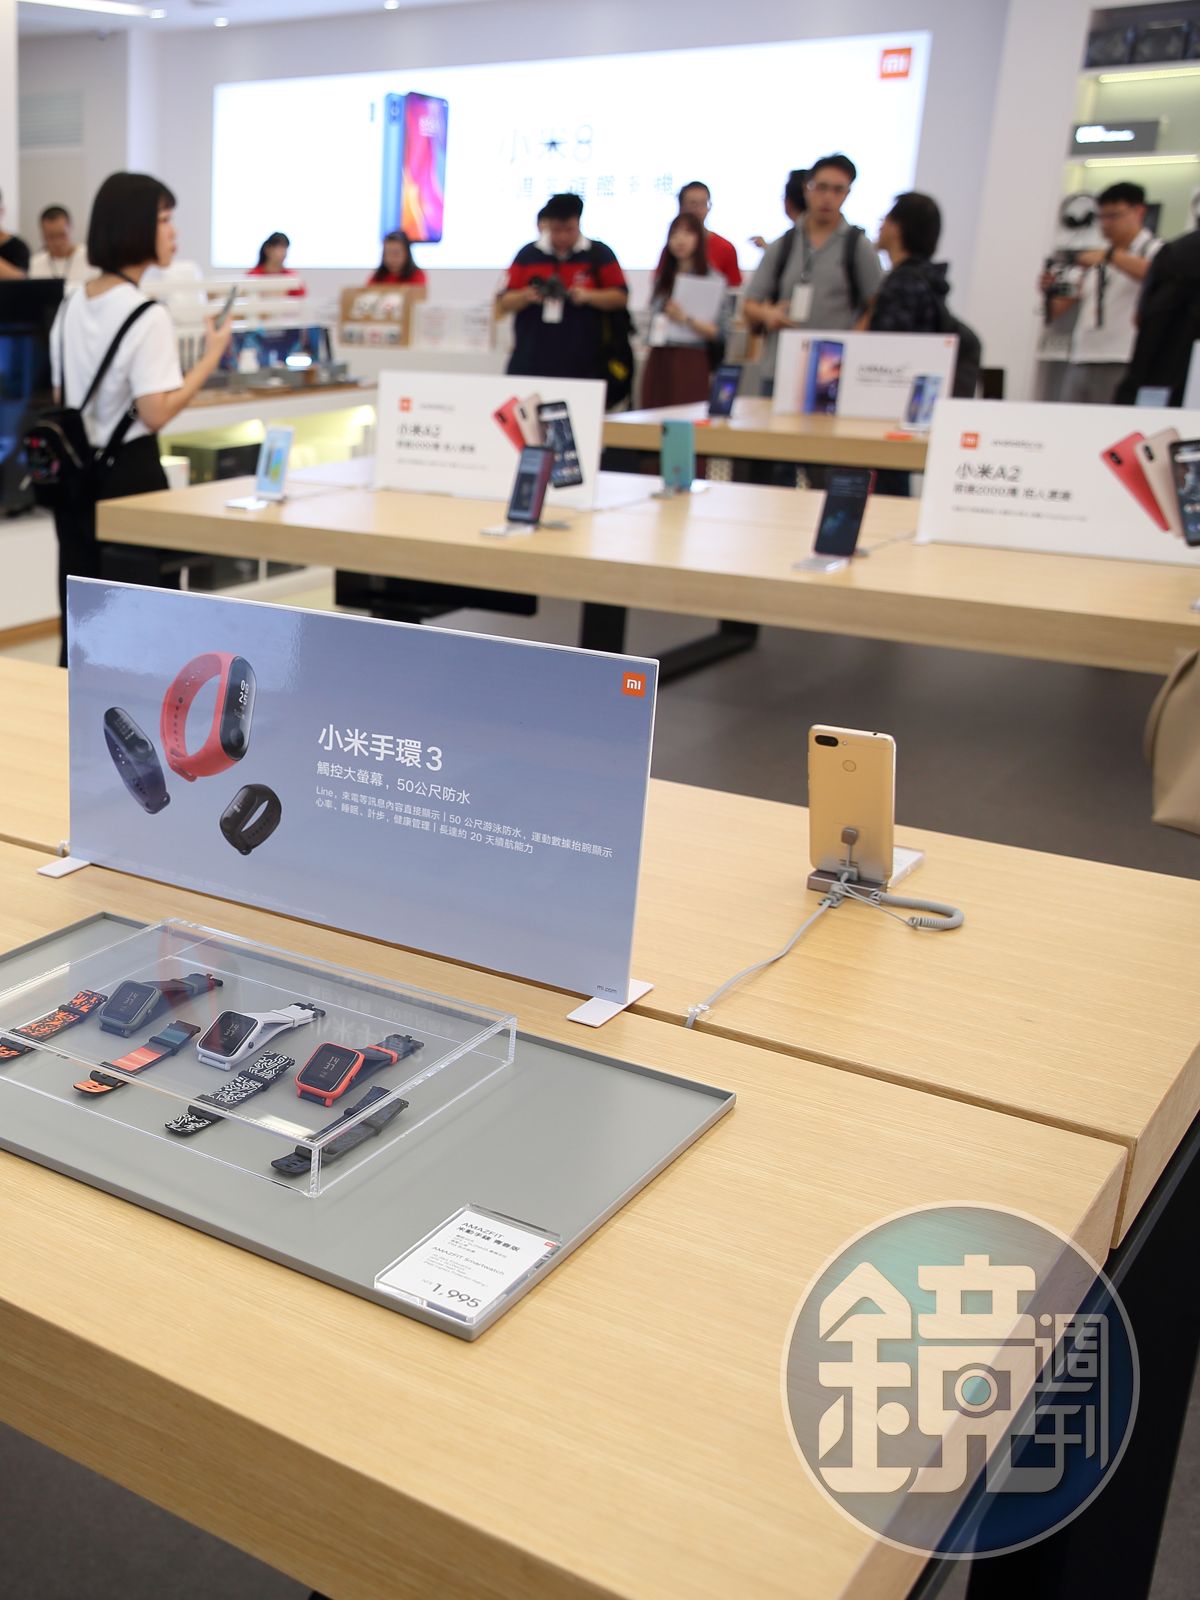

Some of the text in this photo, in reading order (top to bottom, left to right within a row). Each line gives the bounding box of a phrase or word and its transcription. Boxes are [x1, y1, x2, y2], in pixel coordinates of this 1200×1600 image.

[955, 463, 1023, 482] 小米A2
[470, 831, 483, 843] 20
[461, 1222, 504, 1239] AMAZFIT
[464, 1256, 505, 1277] Smartwatch
[431, 1282, 481, 1309] 1,995
